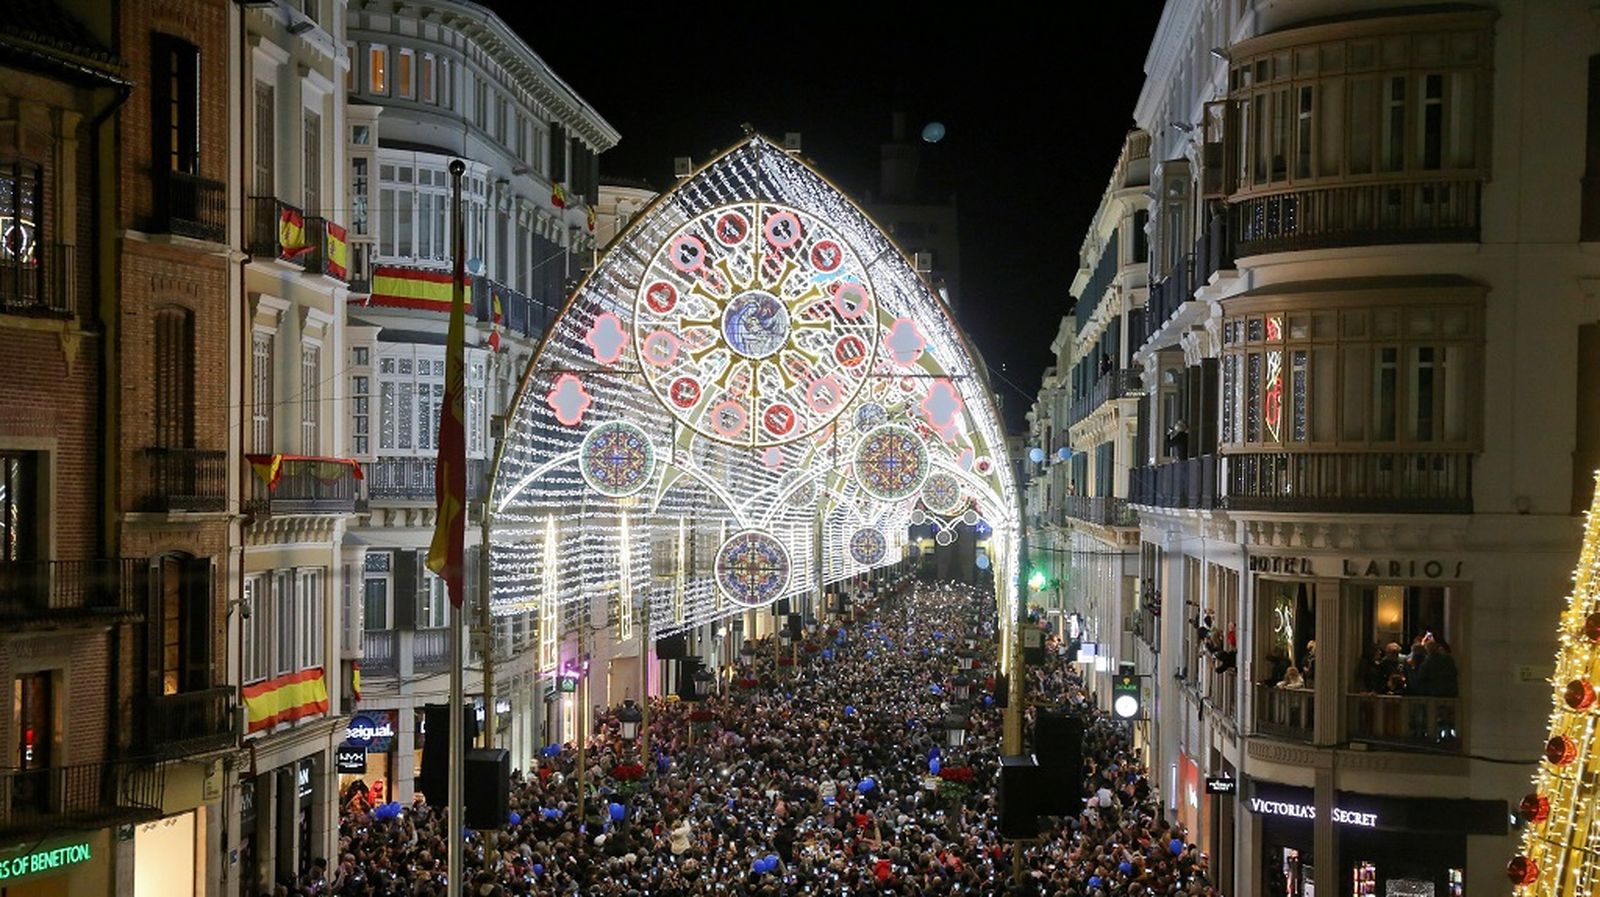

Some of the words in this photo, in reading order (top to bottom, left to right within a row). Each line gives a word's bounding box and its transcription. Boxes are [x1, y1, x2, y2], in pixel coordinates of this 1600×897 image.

[1249, 555, 1314, 575] HOTEL
[1343, 559, 1463, 578] LARIOS
[339, 753, 363, 761] NYX
[1251, 798, 1316, 819] VICTORIA'S
[1332, 807, 1378, 827] SECRET
[12, 855, 29, 876] OF
